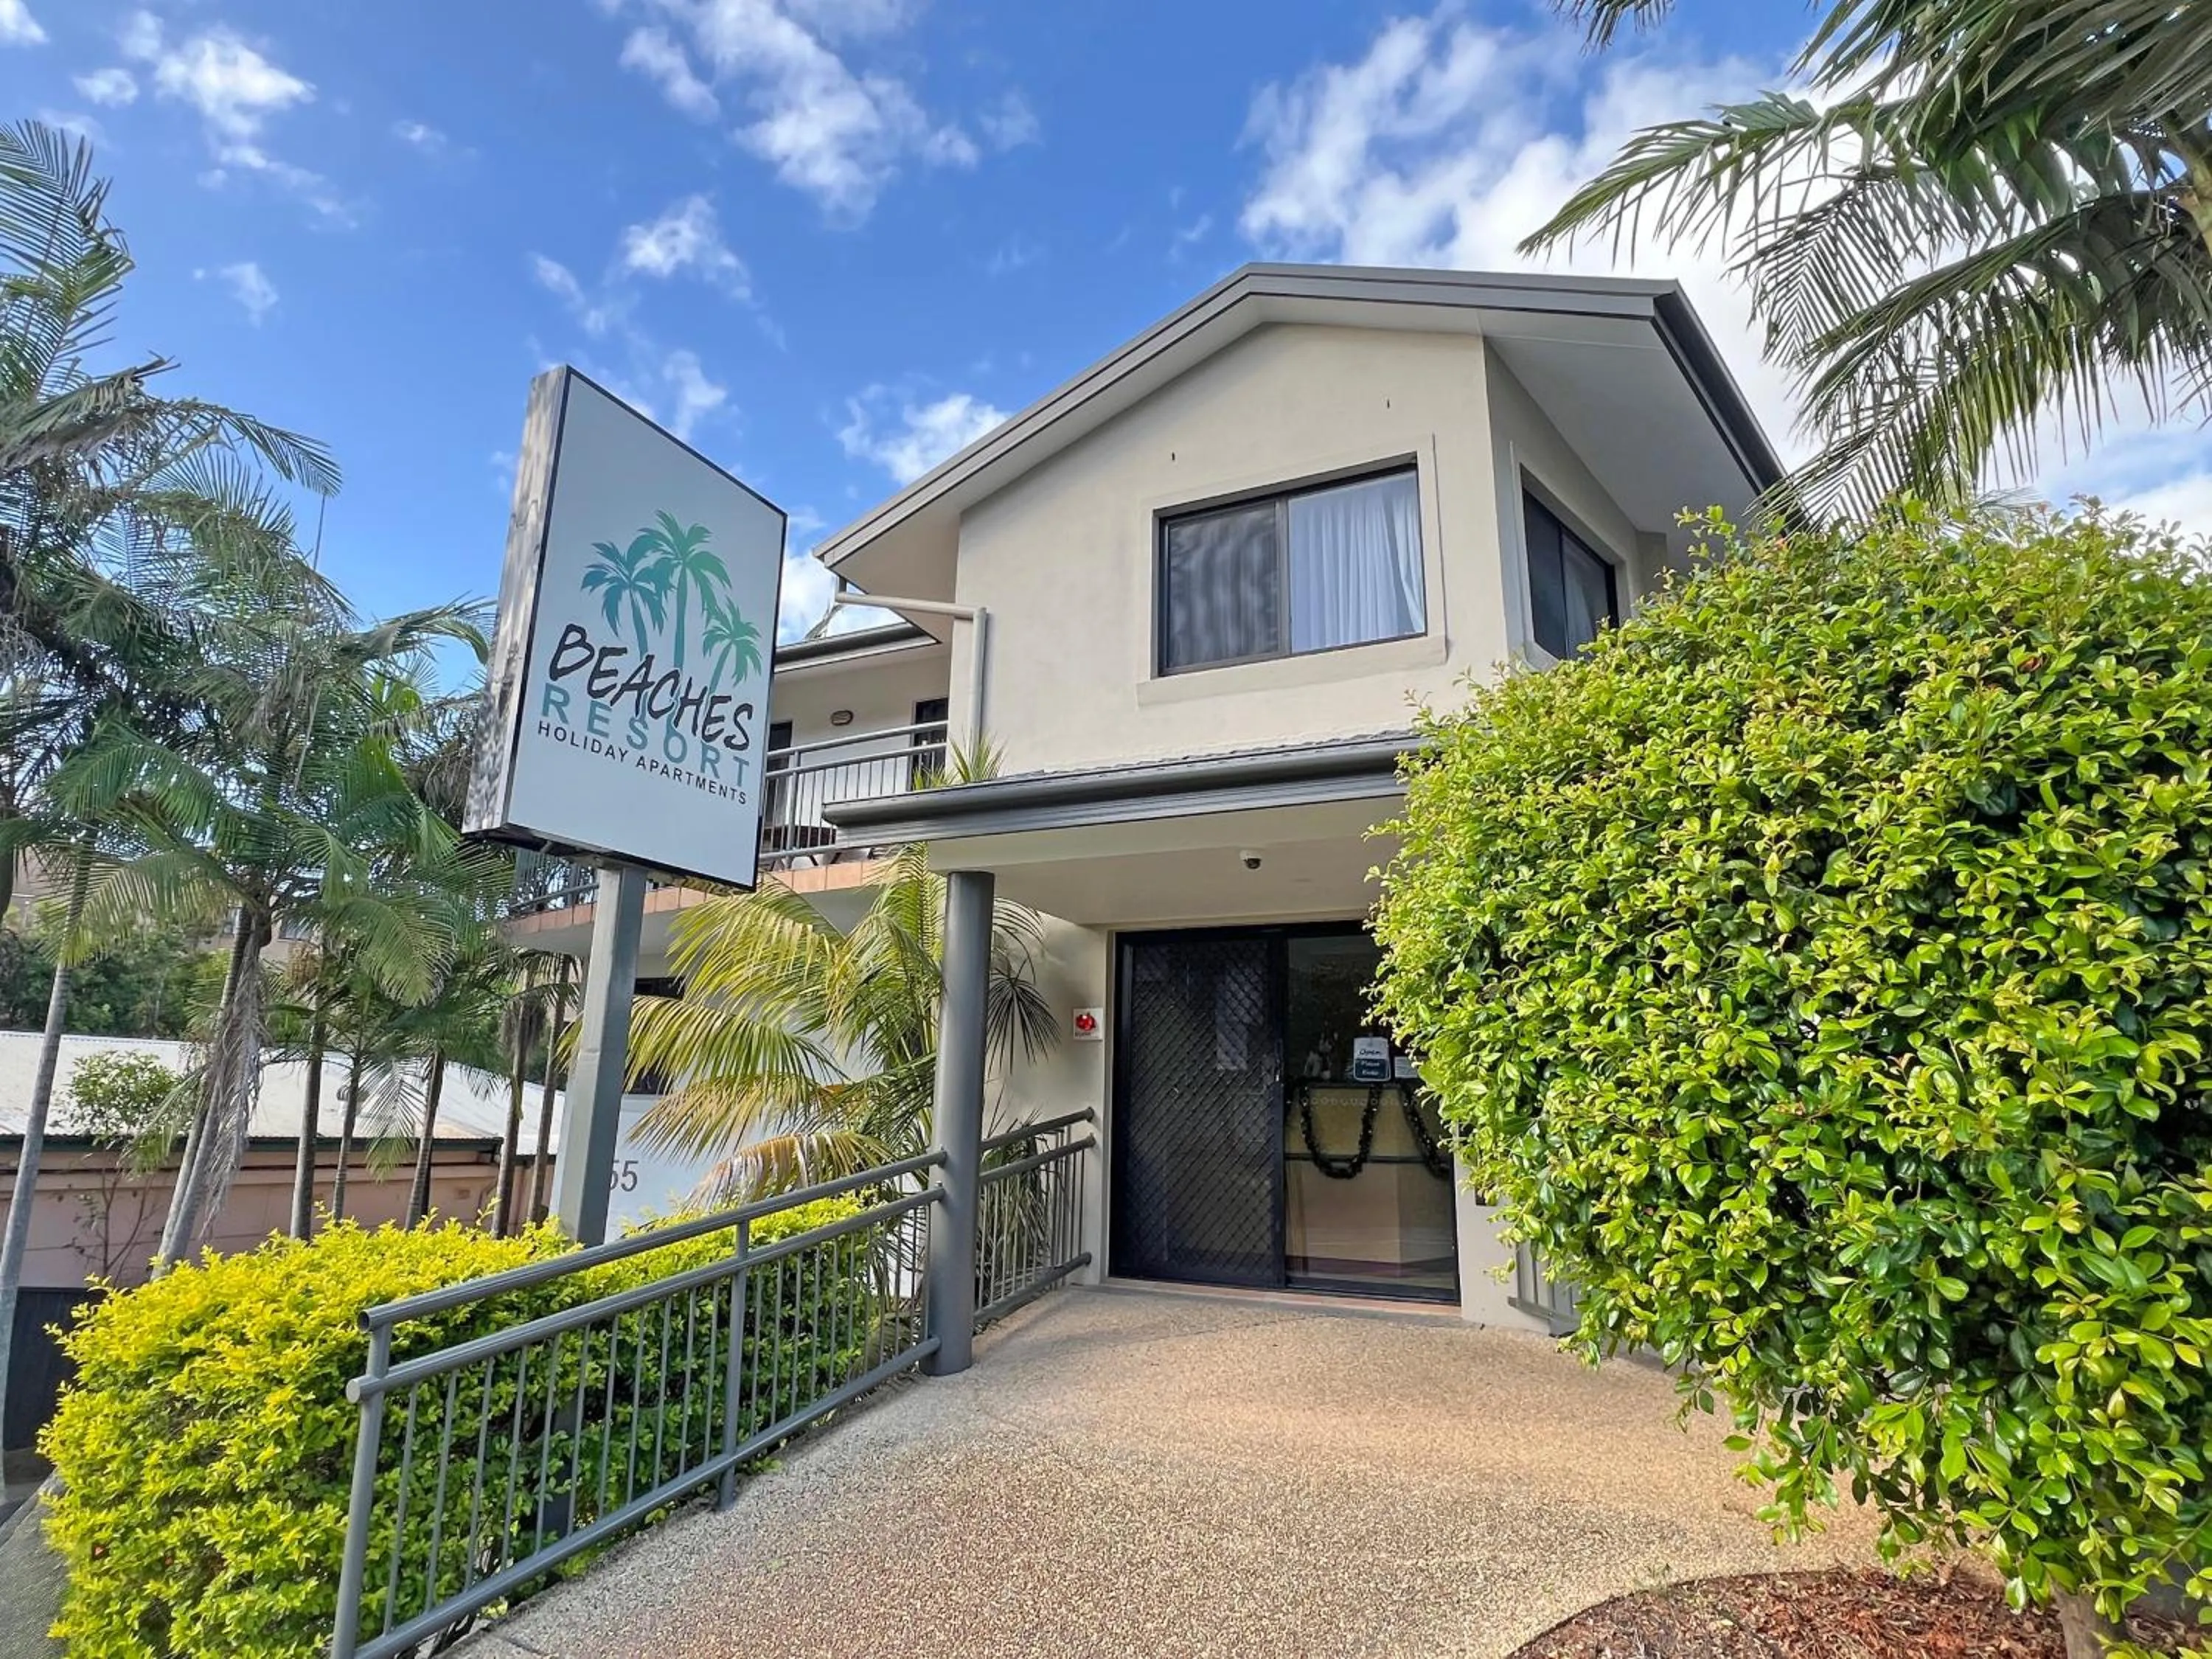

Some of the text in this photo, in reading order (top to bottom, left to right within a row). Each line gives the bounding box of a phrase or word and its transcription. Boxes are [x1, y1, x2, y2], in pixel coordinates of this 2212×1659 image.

[541, 683, 750, 787] RESORT
[549, 624, 753, 751] BEACHES
[538, 720, 747, 804] HOLIDAY APARTMENTS
